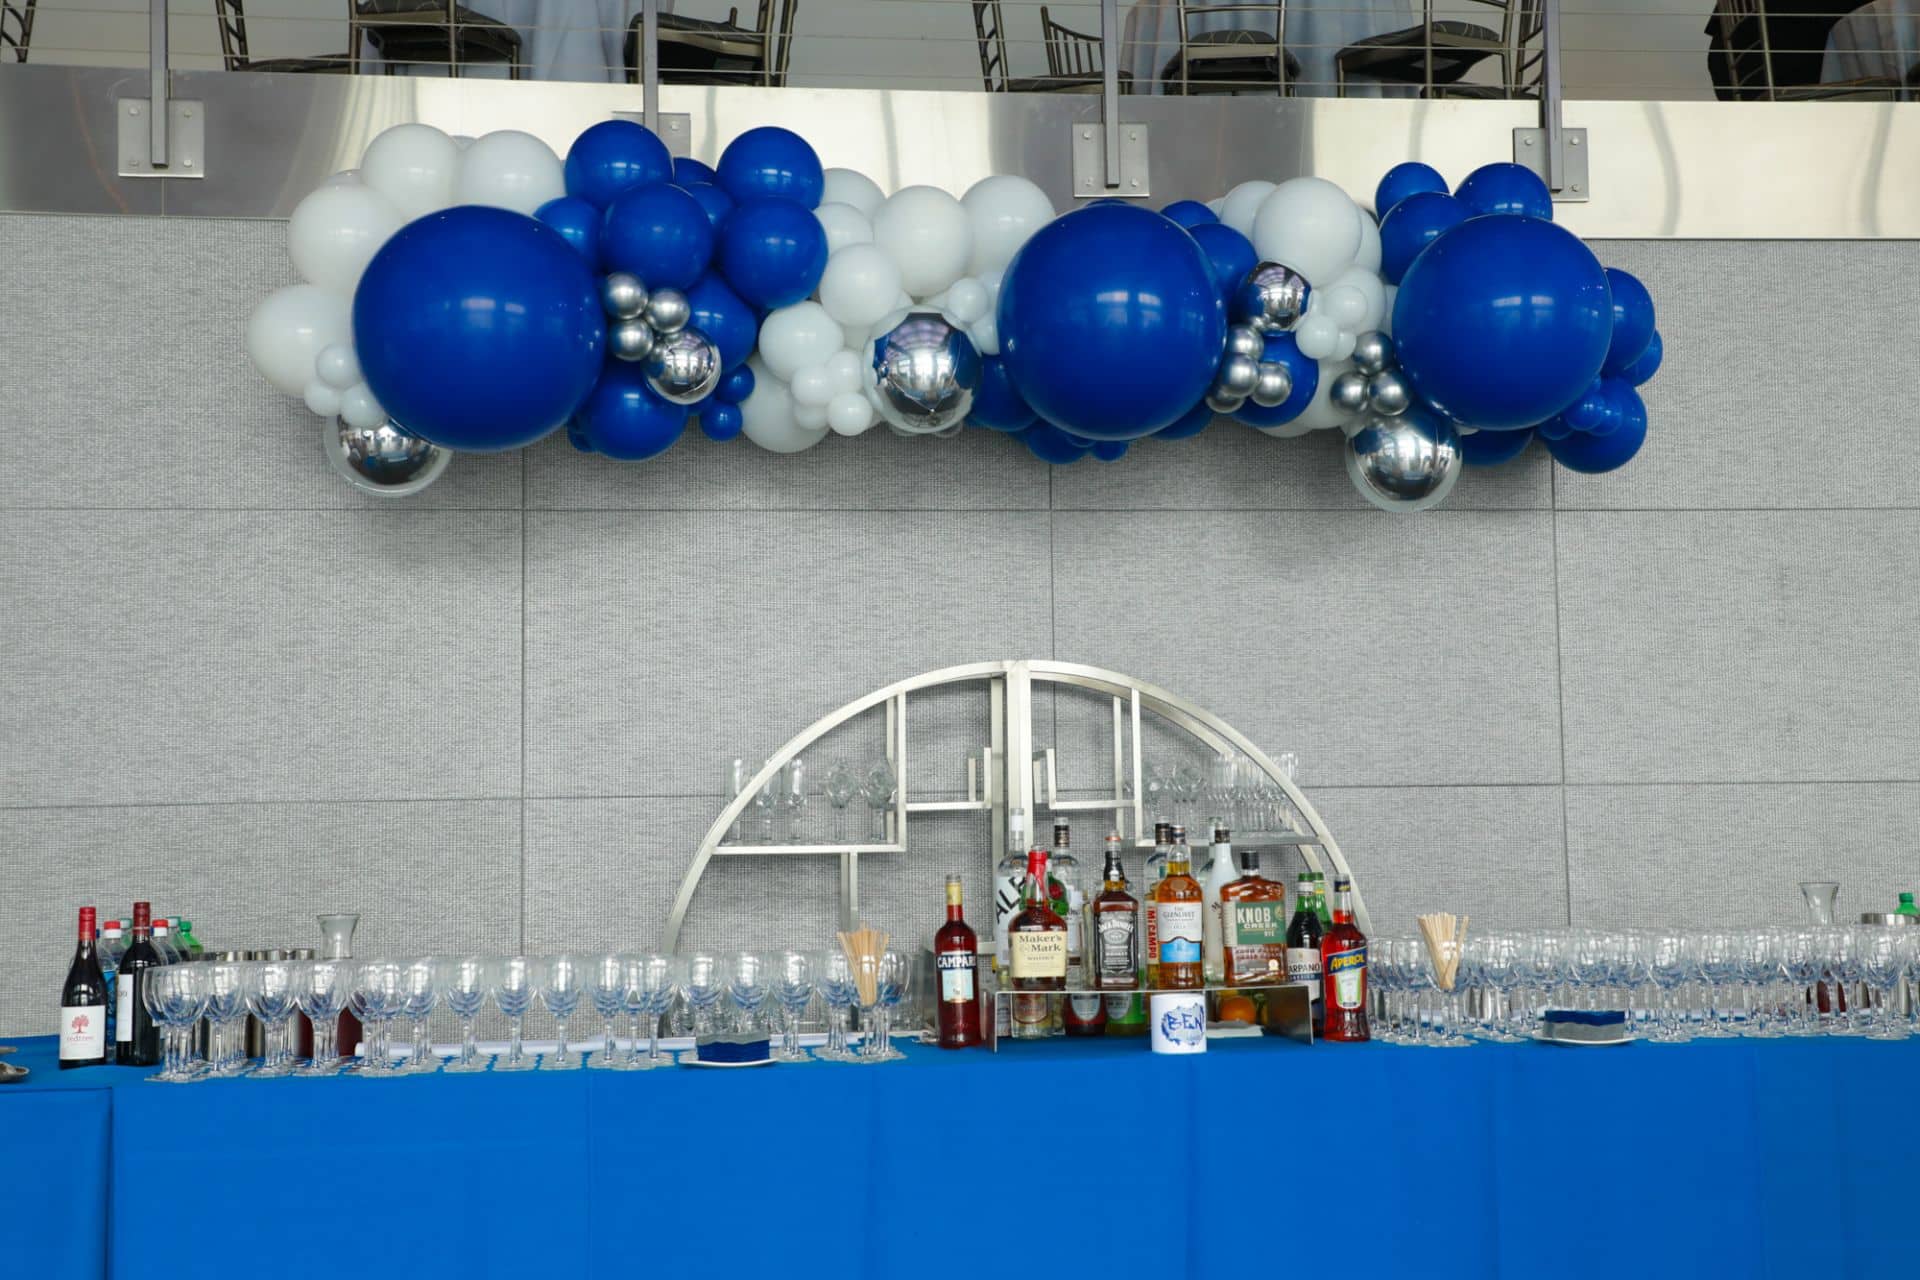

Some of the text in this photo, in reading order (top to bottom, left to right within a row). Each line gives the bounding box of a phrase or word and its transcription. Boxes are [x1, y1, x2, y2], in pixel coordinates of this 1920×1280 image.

[1236, 907, 1271, 923] KNOB
[1019, 935, 1062, 944] Maker's
[1031, 944, 1061, 953] Mark
[1331, 954, 1364, 971] APEROL
[1289, 963, 1320, 973] ARPANO
